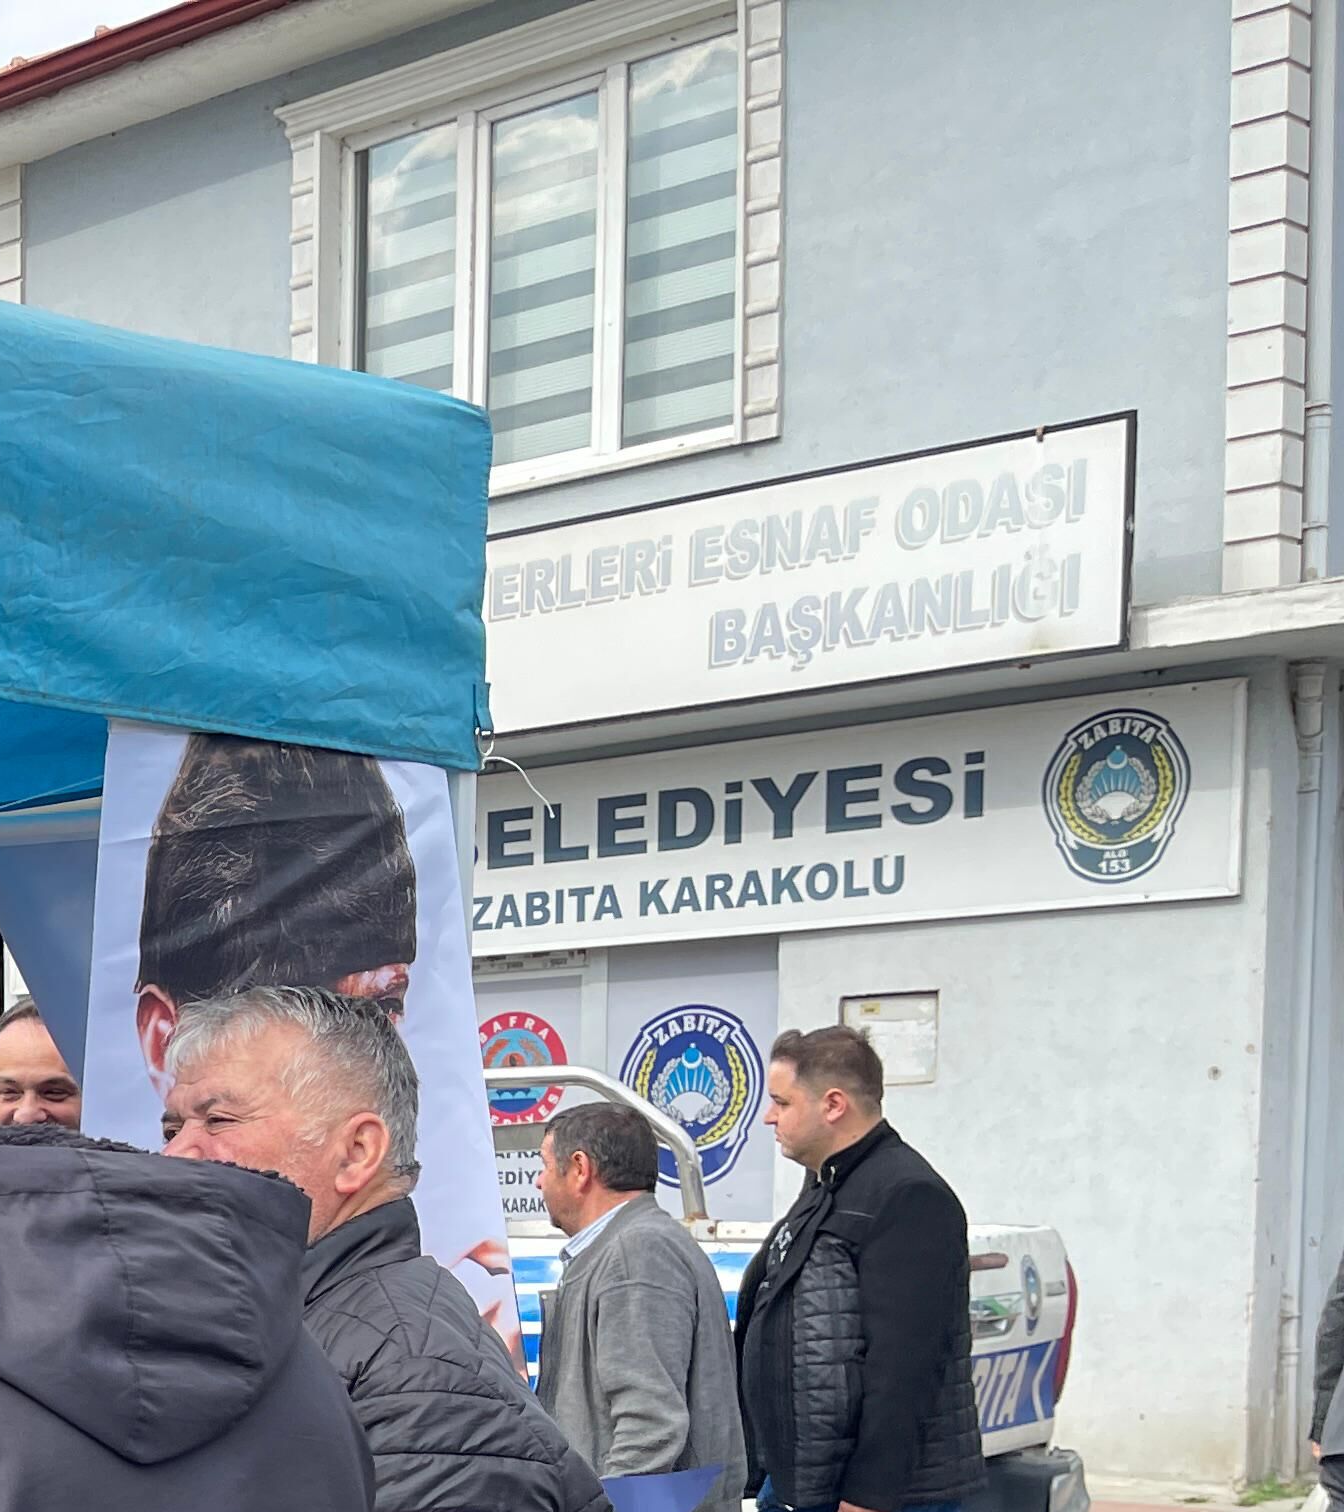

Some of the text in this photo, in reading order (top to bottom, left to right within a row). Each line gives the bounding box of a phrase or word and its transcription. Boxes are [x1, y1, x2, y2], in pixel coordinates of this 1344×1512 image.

[489, 459, 1088, 621] ERLERi ESNAF ODASI
[708, 547, 1081, 672] BAŞKANLIĞI
[1078, 718, 1157, 750] ZABITA
[475, 750, 986, 870] ELEDiYESi
[473, 855, 906, 931] ZABITA KARAKOLU
[1098, 860, 1131, 873] 153
[652, 1015, 730, 1046] ZABITA
